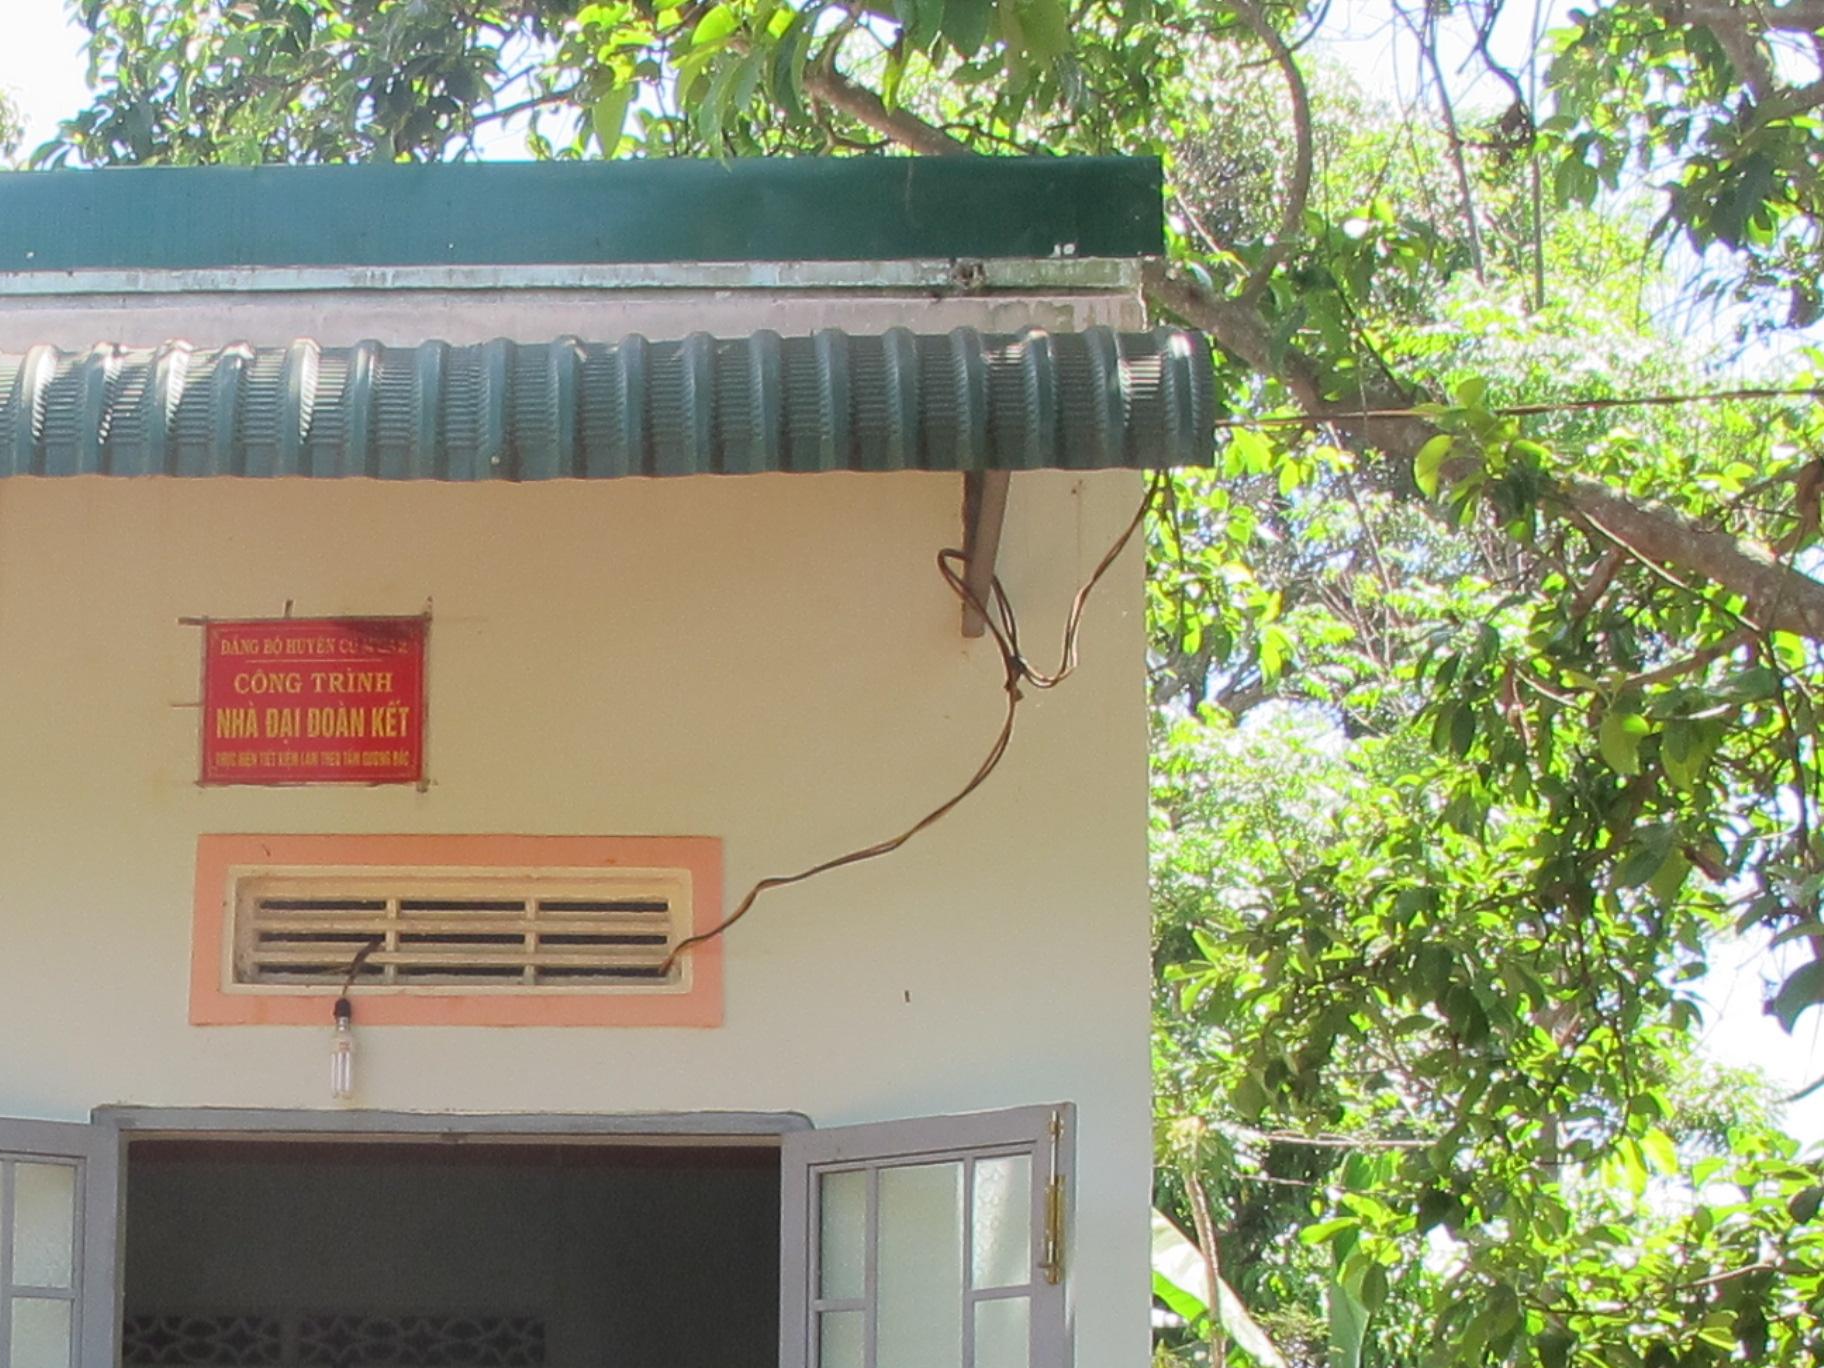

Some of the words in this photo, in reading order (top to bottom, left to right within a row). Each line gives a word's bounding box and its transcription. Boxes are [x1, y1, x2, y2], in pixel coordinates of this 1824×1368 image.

[234, 669, 302, 694] CÔNG
[311, 668, 393, 693] TRÌNH
[216, 701, 259, 738] NHÀ
[266, 706, 301, 744] ĐẠI
[307, 701, 364, 738] ĐOÀN
[371, 700, 410, 738] KẾT
